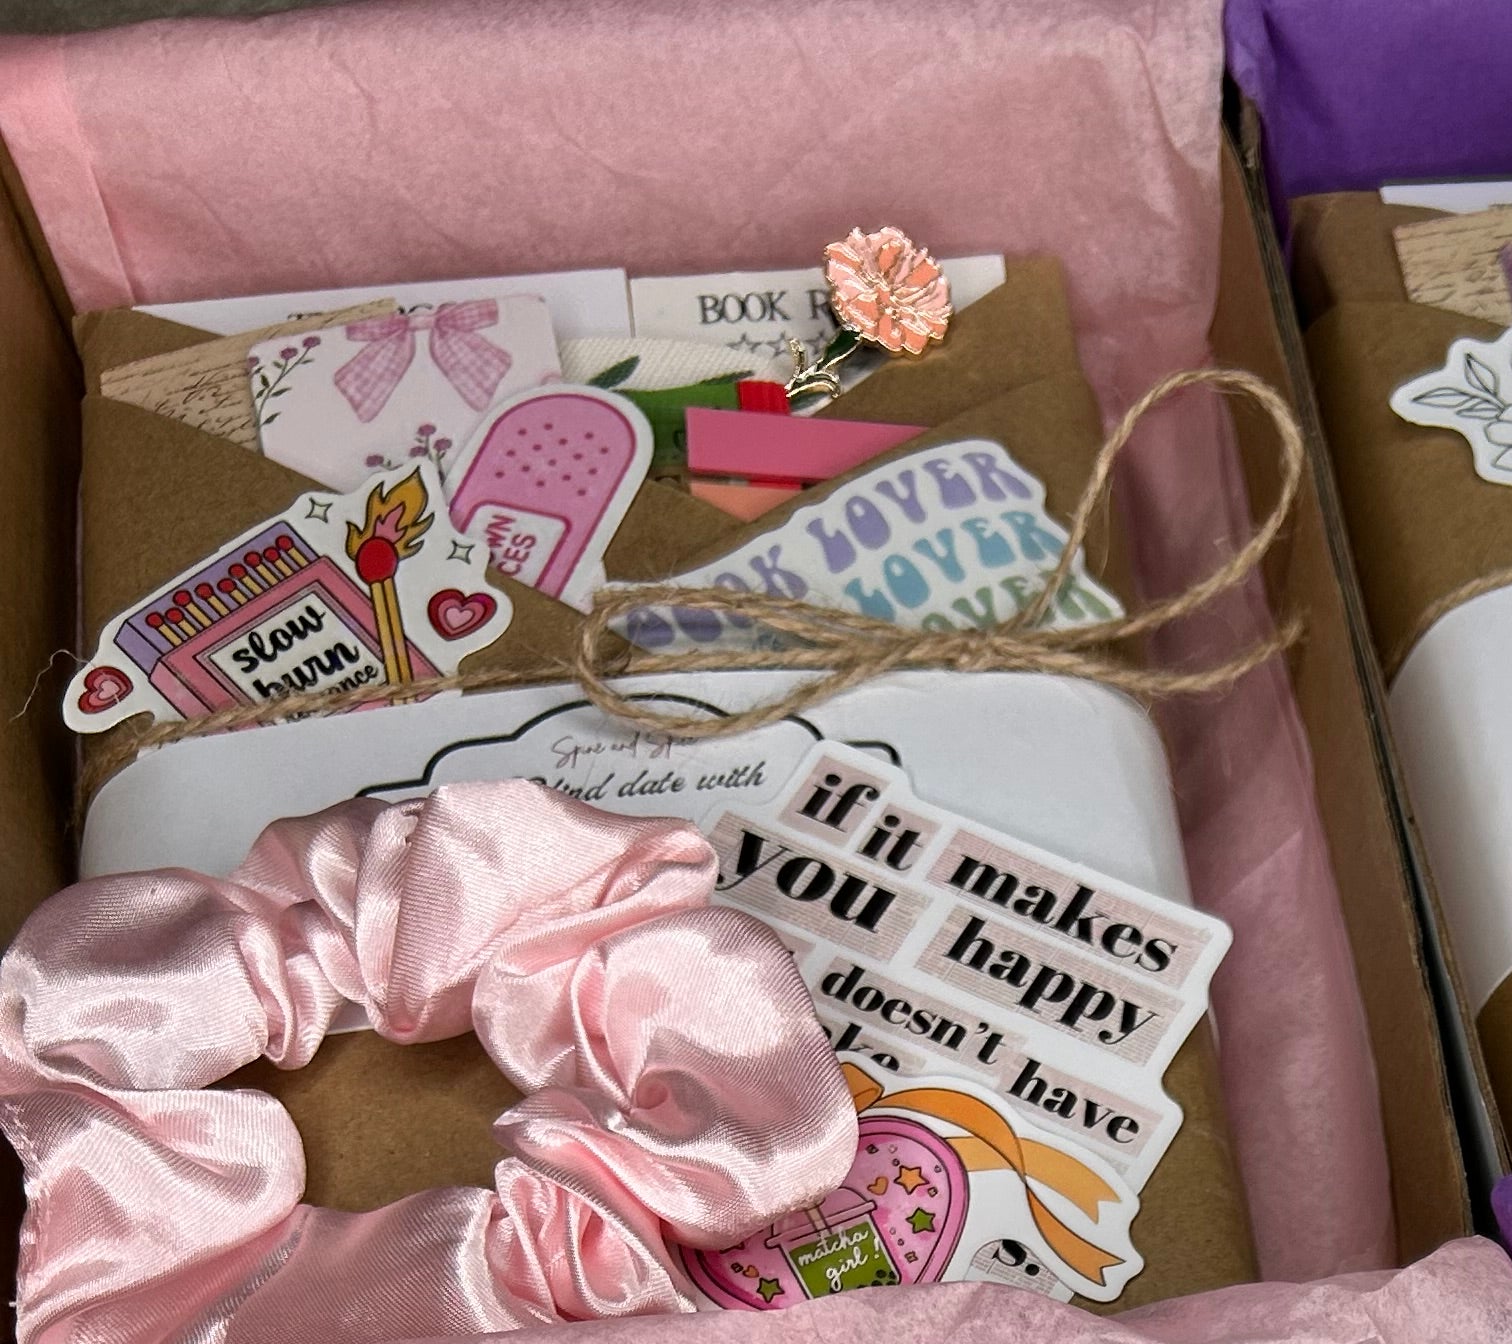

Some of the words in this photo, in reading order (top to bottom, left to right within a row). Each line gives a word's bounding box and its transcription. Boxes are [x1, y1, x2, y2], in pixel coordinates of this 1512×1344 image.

[697, 289, 790, 325] BOOK
[805, 451, 1033, 574] LOVER
[844, 510, 1068, 623] LOVER
[232, 605, 327, 673] slow
[252, 642, 361, 698] burn
[618, 769, 688, 799] date
[696, 761, 767, 791] with
[796, 773, 880, 833] if
[855, 814, 925, 872] it
[947, 852, 1179, 974] makes
[715, 829, 898, 934] you
[943, 914, 1161, 1045] happy
[1006, 1056, 1141, 1146] have
[798, 1228, 869, 1268] matcha
